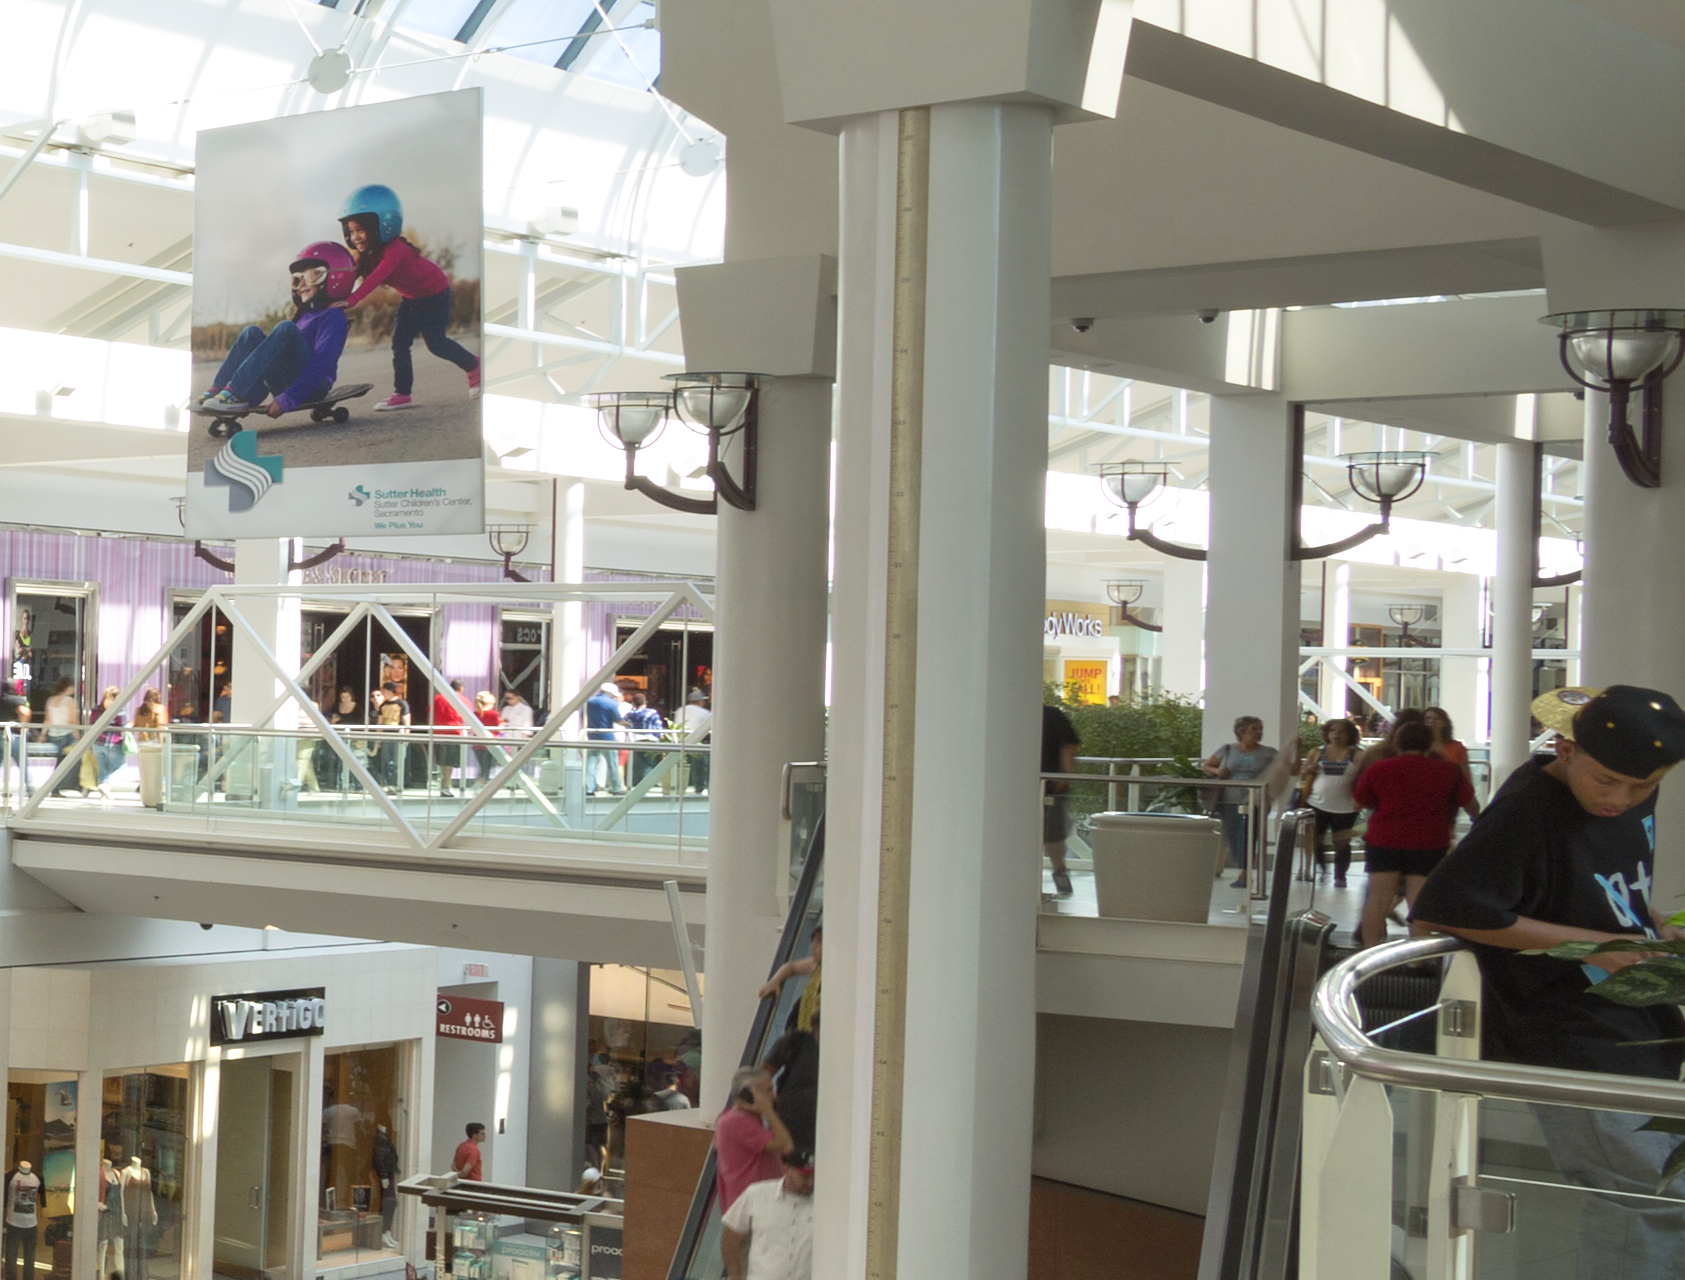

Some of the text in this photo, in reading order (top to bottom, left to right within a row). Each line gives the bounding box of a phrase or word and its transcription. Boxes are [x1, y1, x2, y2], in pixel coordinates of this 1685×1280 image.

[374, 487, 447, 499] Sutter Health
[373, 501, 398, 509] Sutter
[400, 499, 441, 508] Children's
[373, 510, 424, 518] Sacramento
[374, 521, 424, 529] We Plus You
[1062, 612, 1103, 637] Works
[1071, 668, 1102, 679] JUMP
[439, 1022, 496, 1040] RESTROOMS
